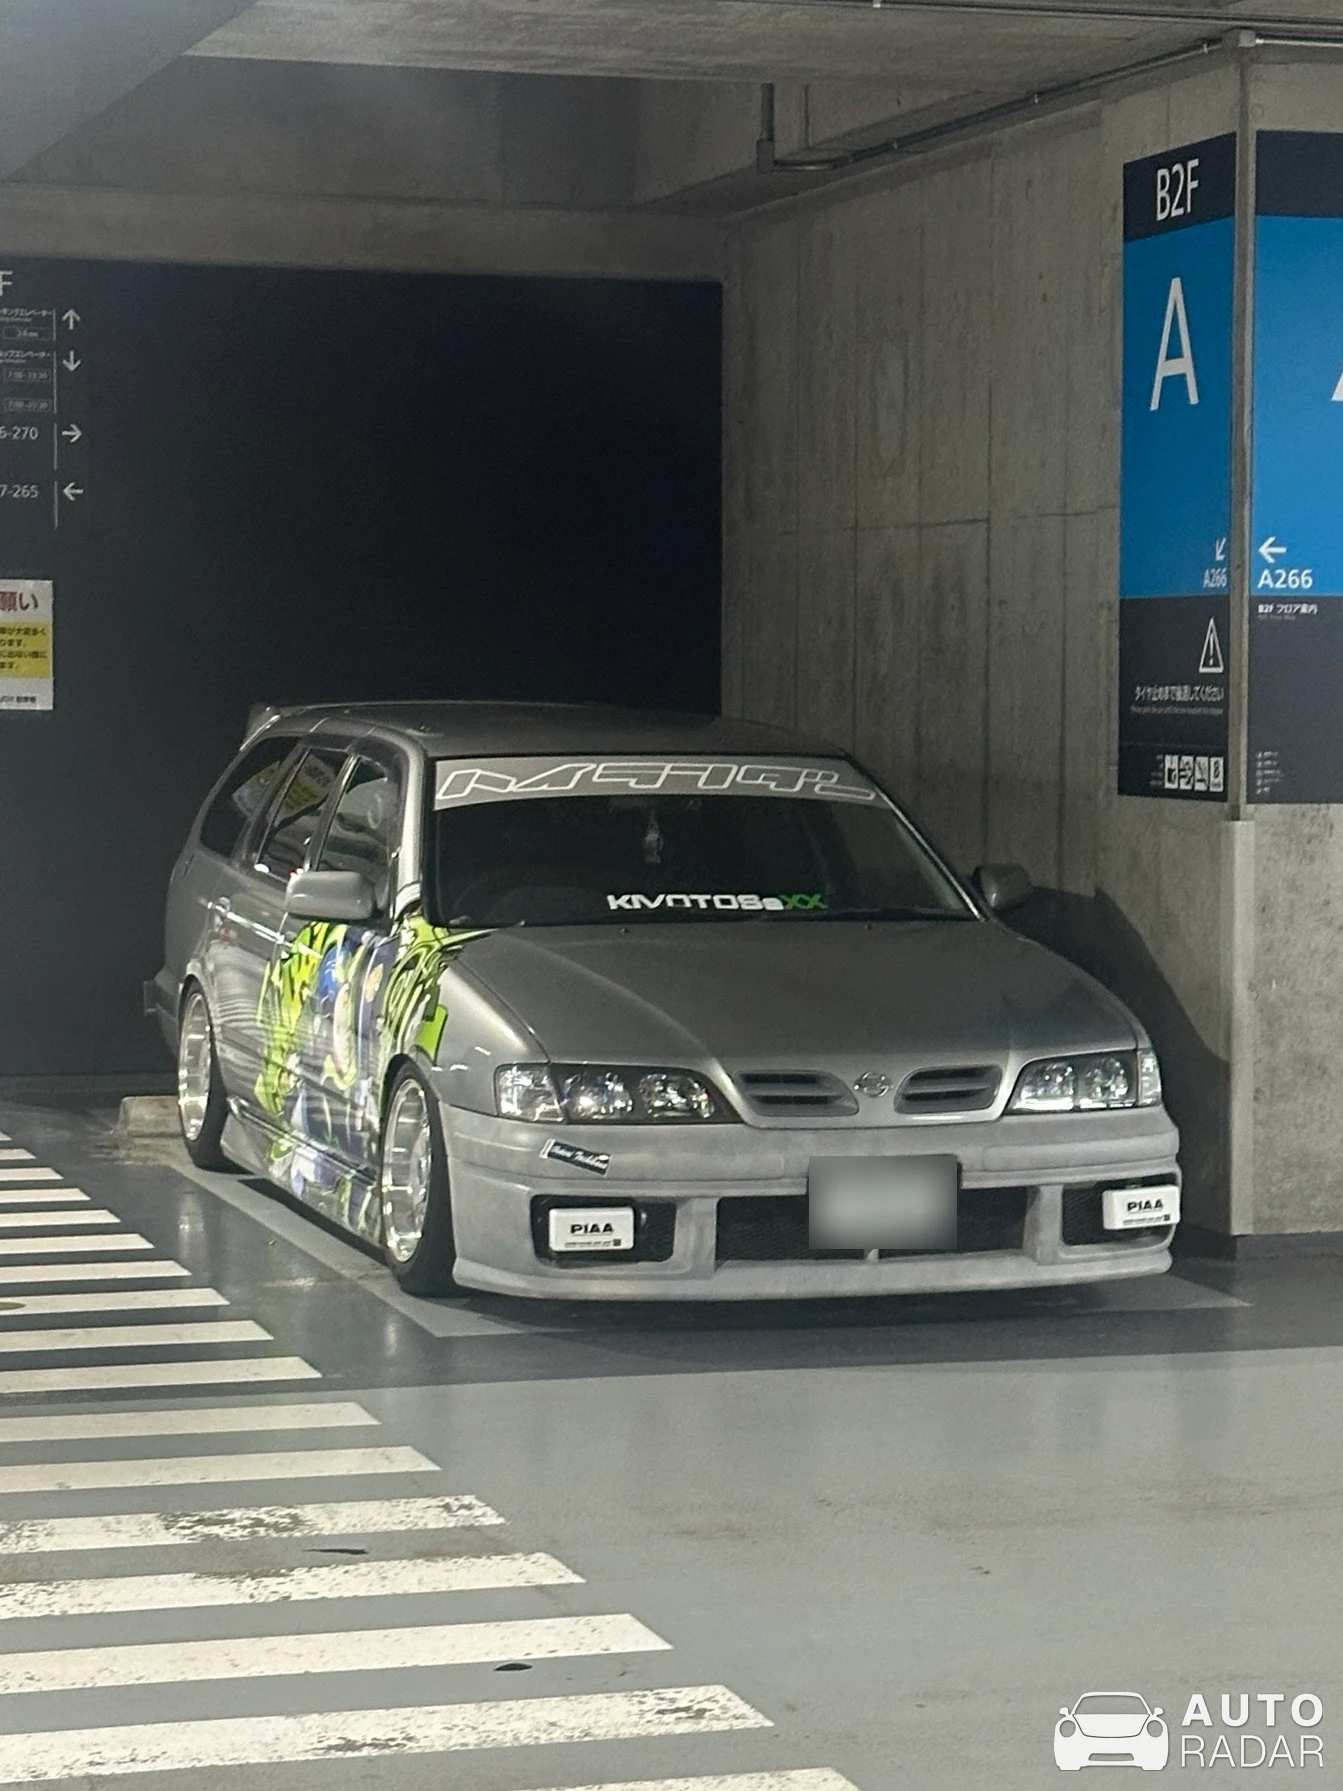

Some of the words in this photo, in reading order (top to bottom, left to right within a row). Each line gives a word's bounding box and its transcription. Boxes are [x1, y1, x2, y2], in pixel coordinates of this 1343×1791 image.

[1156, 158, 1199, 221] B2F
[1149, 276, 1199, 412] A
[1203, 567, 1228, 589] A266
[1257, 568, 1314, 589] A266
[1126, 1199, 1163, 1212] PIAA
[570, 1223, 614, 1235] PIAA
